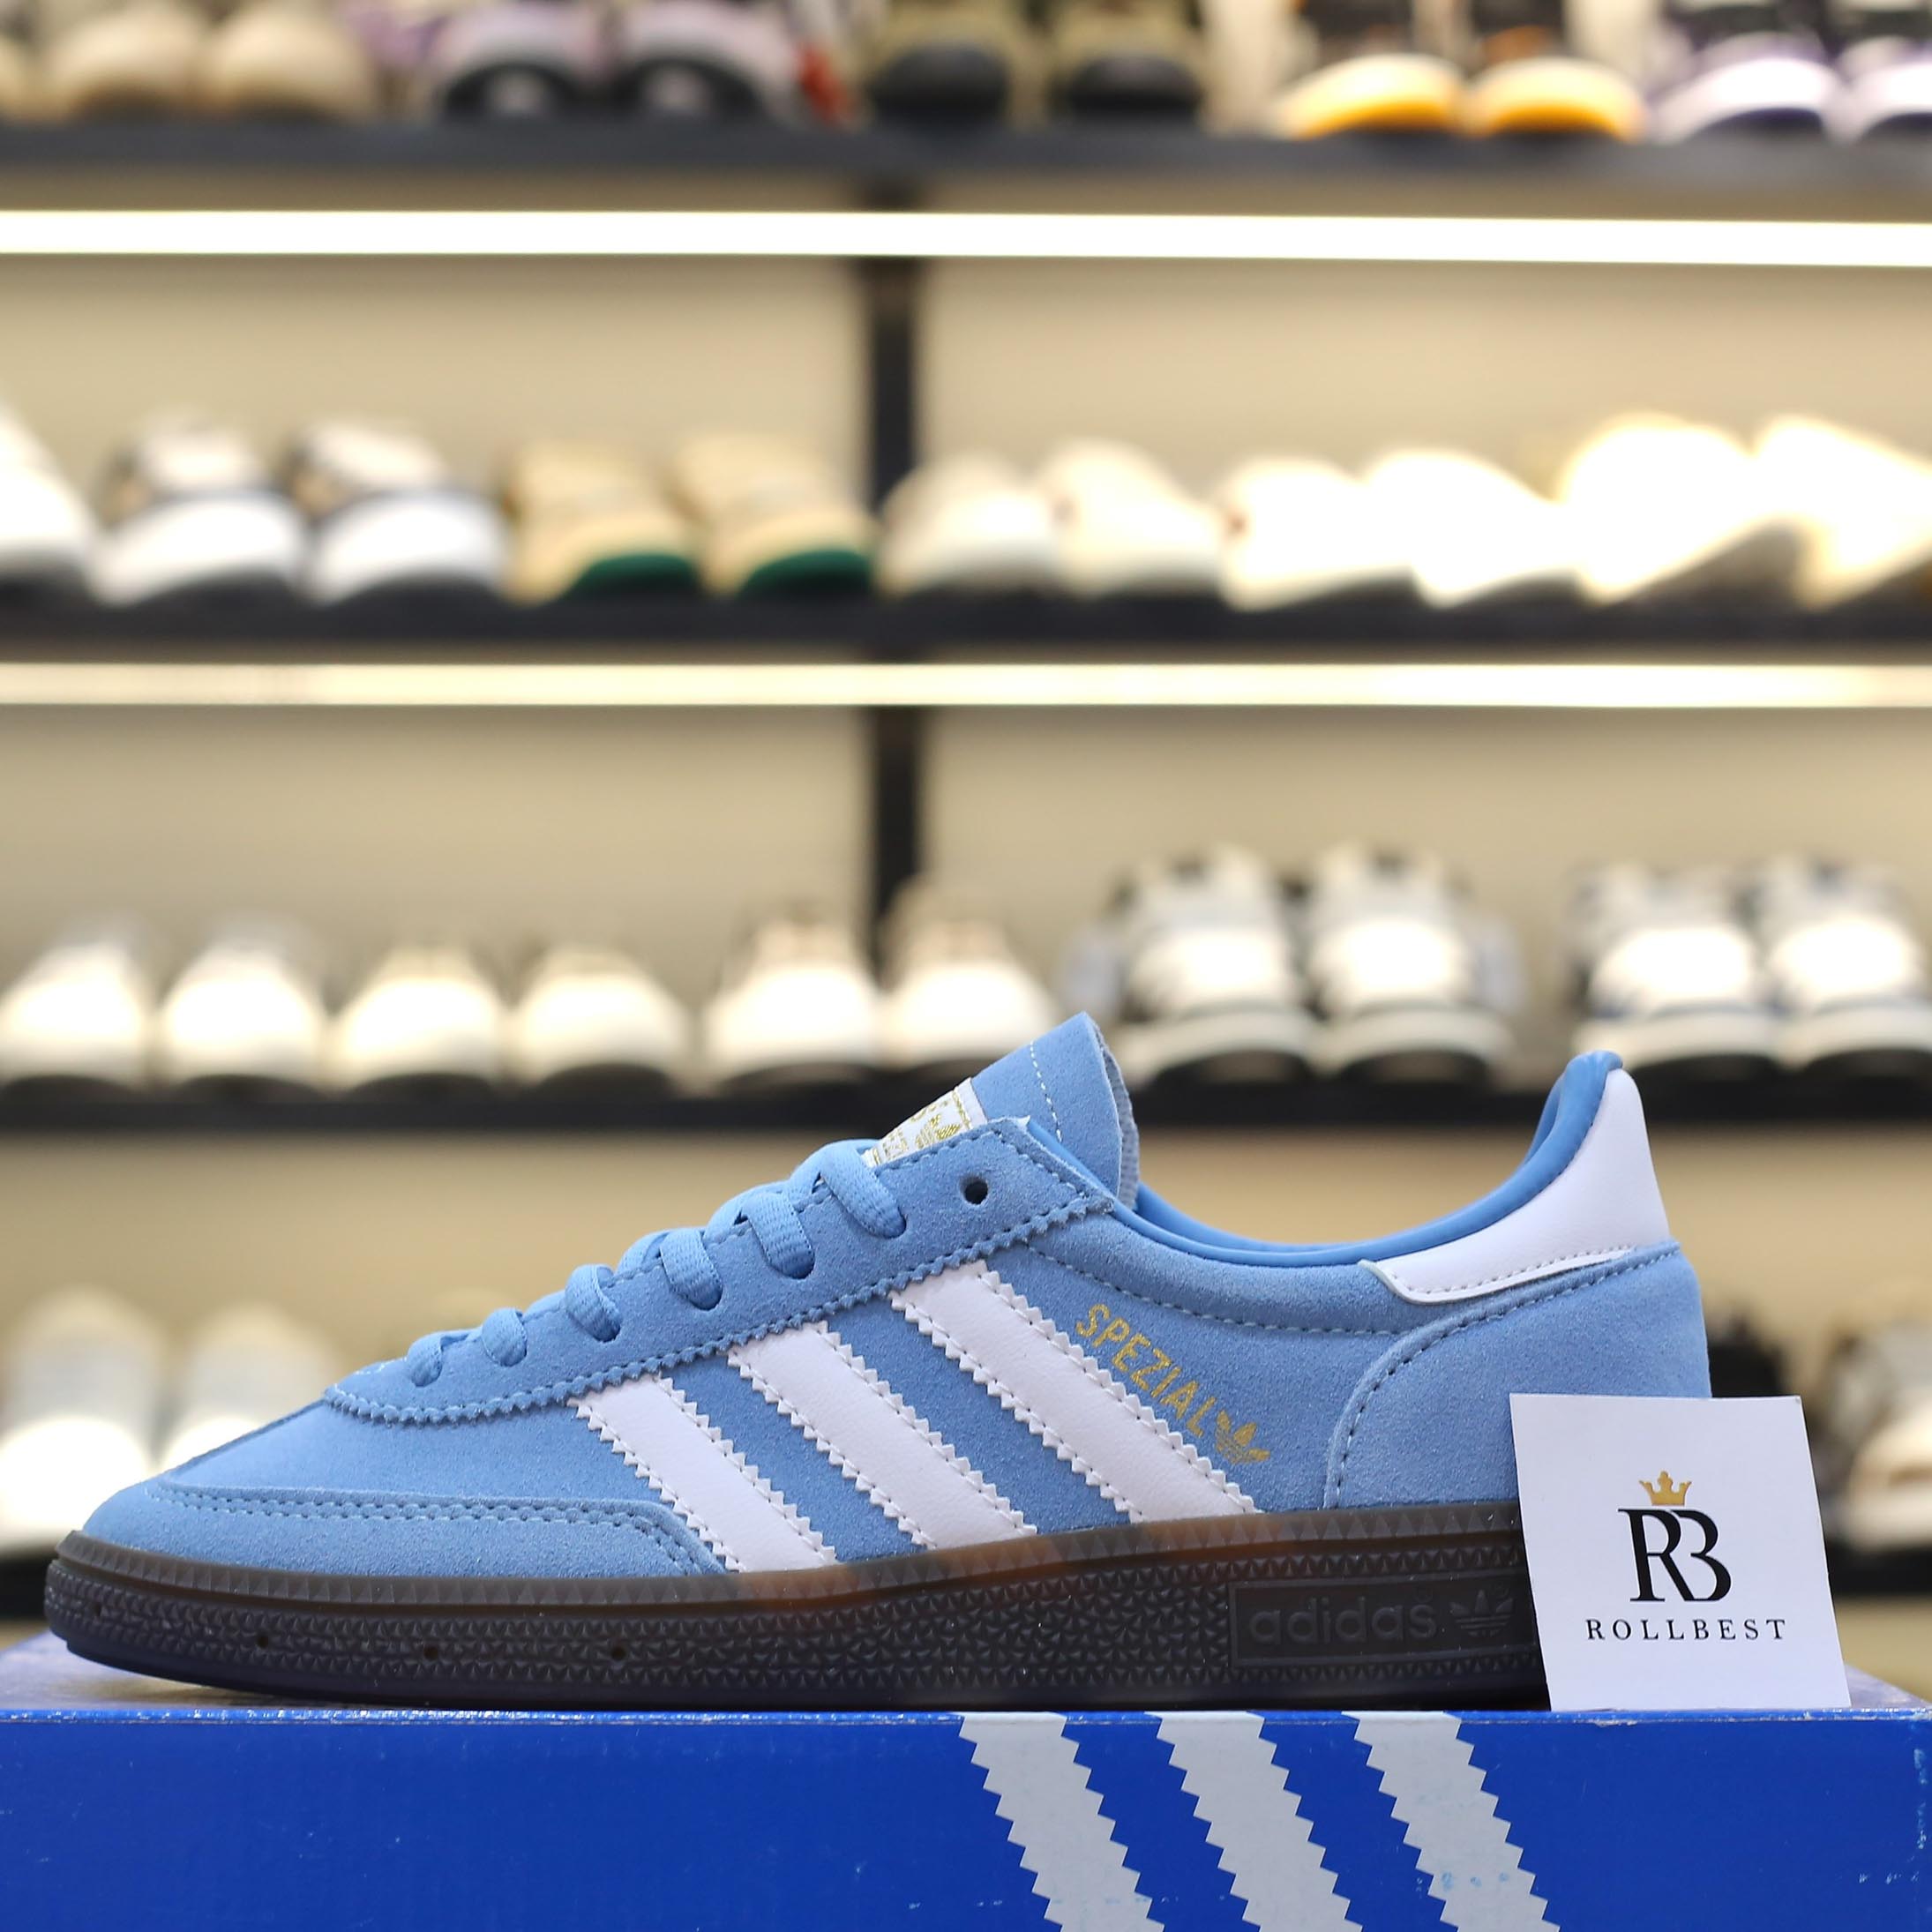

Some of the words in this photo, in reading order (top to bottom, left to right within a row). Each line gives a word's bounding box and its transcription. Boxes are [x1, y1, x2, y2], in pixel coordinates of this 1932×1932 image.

[1075, 1303, 1217, 1438] SPEZIAL
[1617, 1509, 1732, 1602] RB
[1248, 1594, 1439, 1645] adidas
[1585, 1618, 1786, 1641] ROLLBEST
